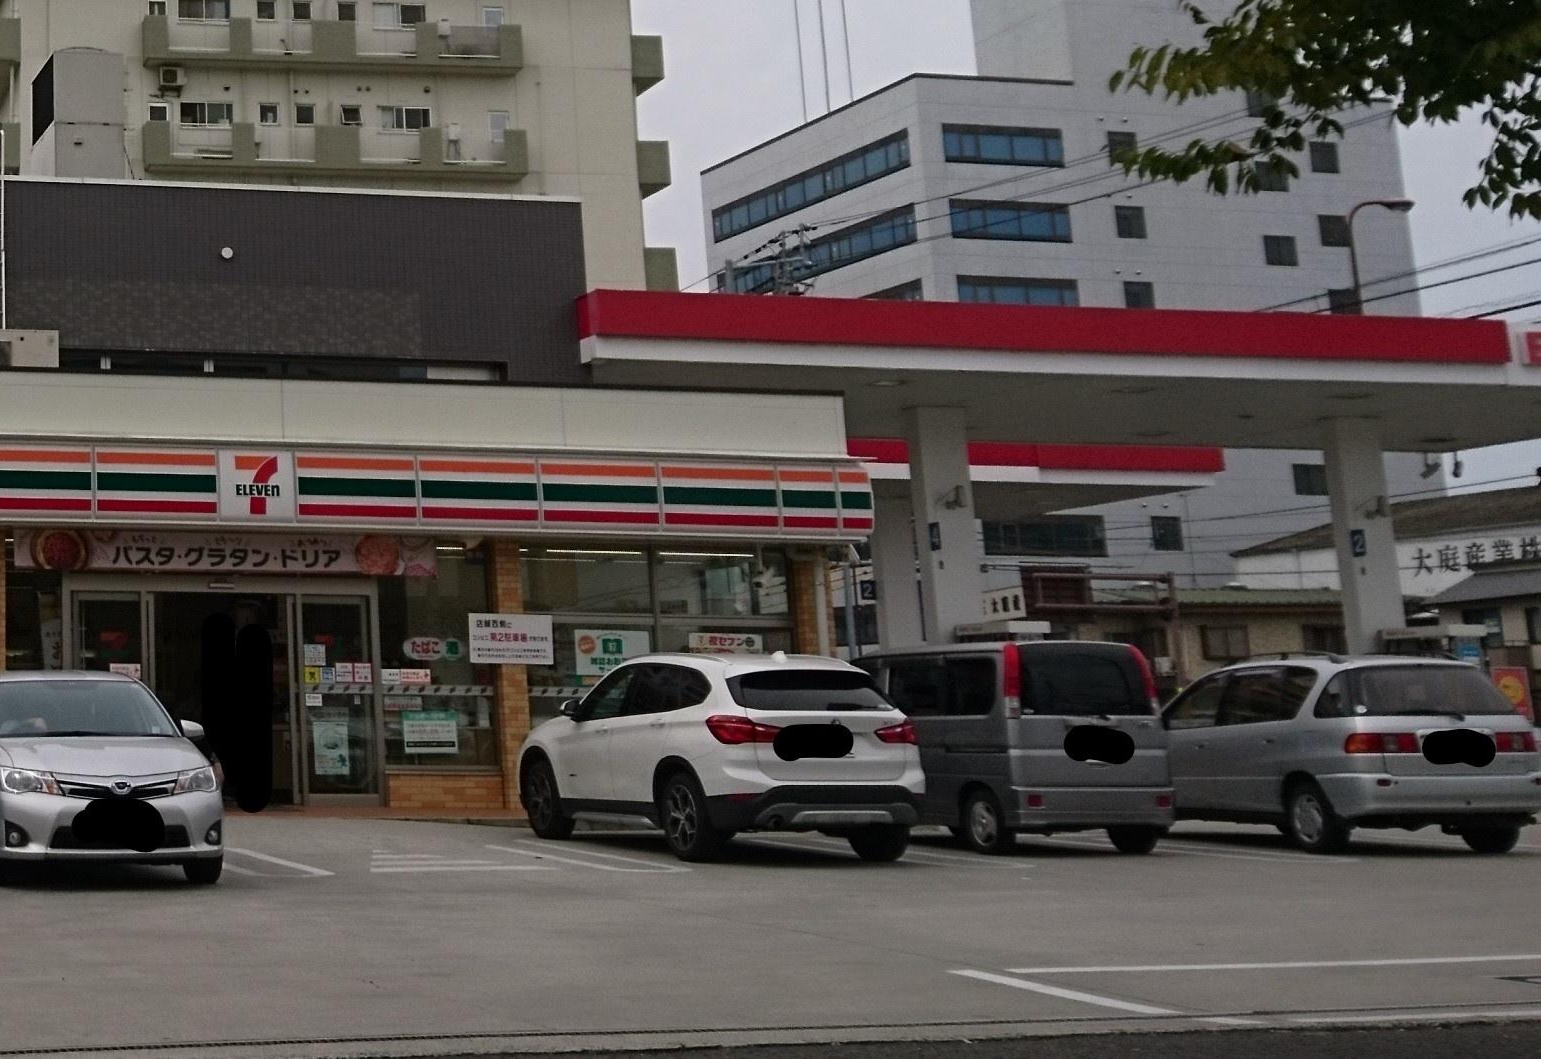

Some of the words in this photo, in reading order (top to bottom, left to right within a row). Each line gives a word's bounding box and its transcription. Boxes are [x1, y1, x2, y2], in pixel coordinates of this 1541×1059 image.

[235, 455, 278, 515] 7
[1353, 533, 1364, 553] 2
[862, 583, 873, 598] 2
[410, 640, 441, 655] たばこ
